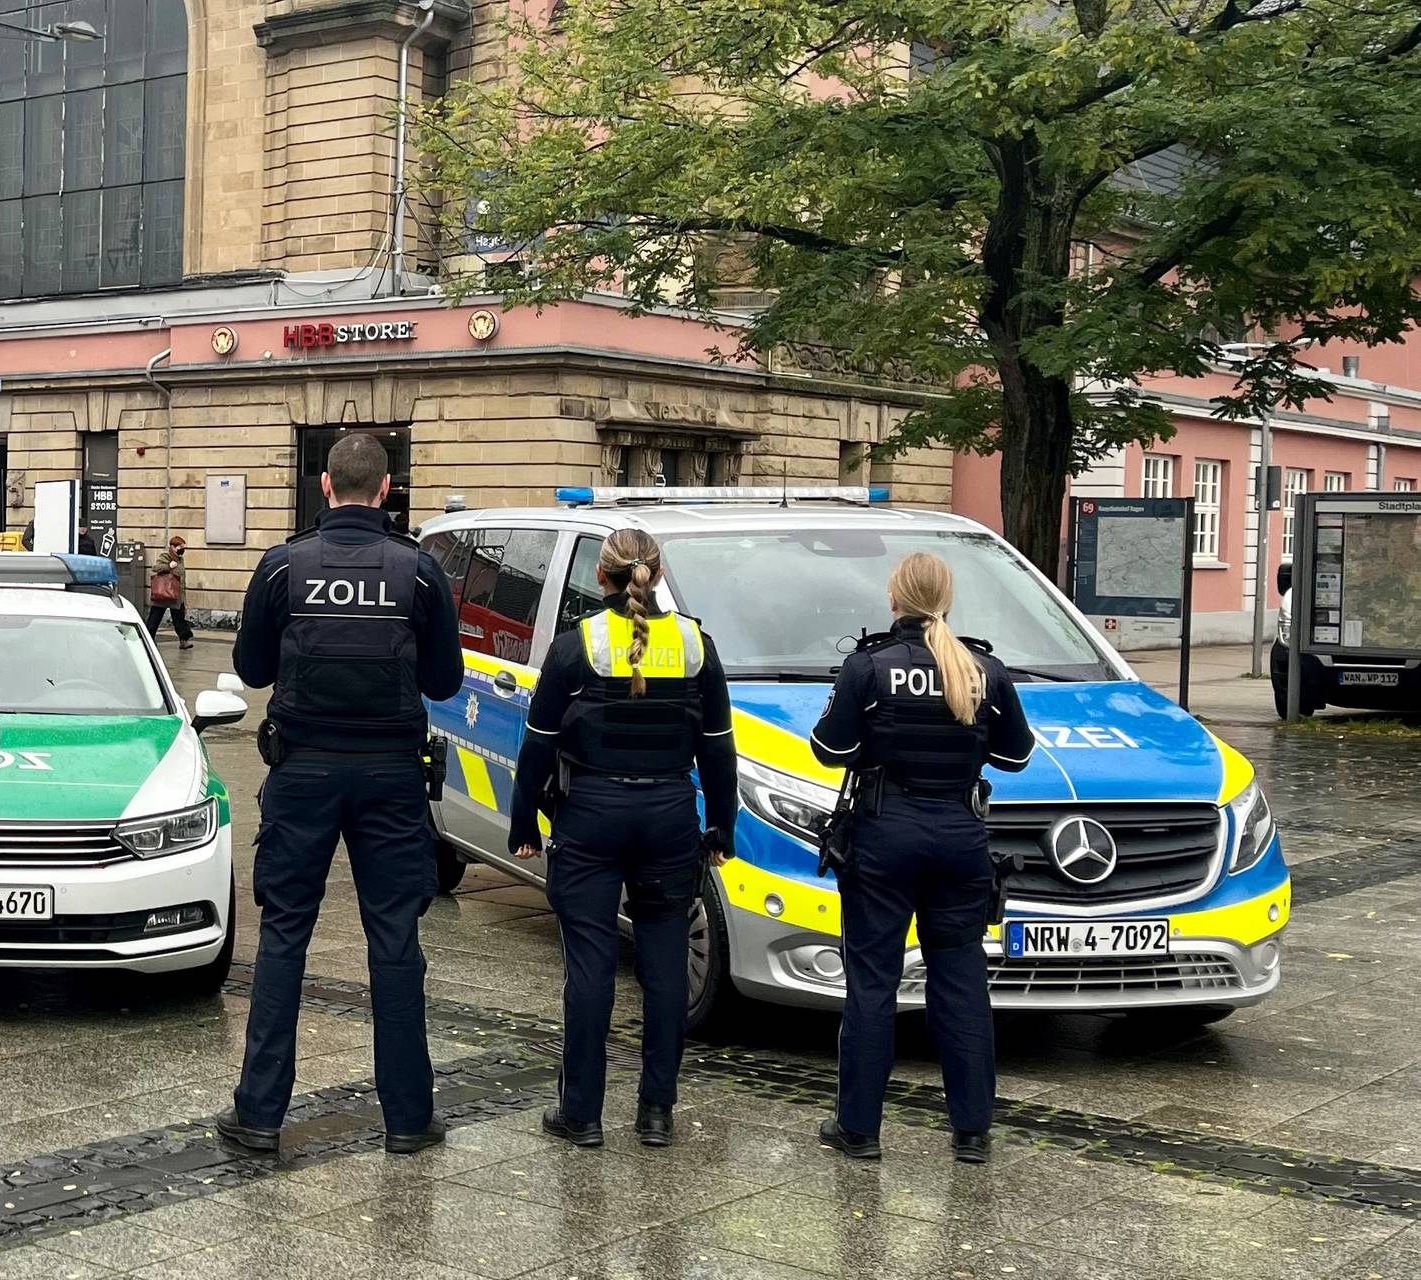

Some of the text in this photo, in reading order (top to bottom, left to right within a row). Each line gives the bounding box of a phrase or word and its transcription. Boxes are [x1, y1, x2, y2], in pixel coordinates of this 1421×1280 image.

[284, 321, 411, 350] HBB STORE
[90, 502, 117, 511] STORE
[93, 490, 113, 501] HBB
[1378, 501, 1421, 512] Stadtpla
[1082, 502, 1094, 513] 69
[304, 579, 397, 607] ZOLL
[614, 646, 682, 668] PIZEI
[890, 667, 987, 700] POLI
[1028, 726, 1140, 749] IZEI
[1012, 924, 1166, 952] D NRW 4-7092
